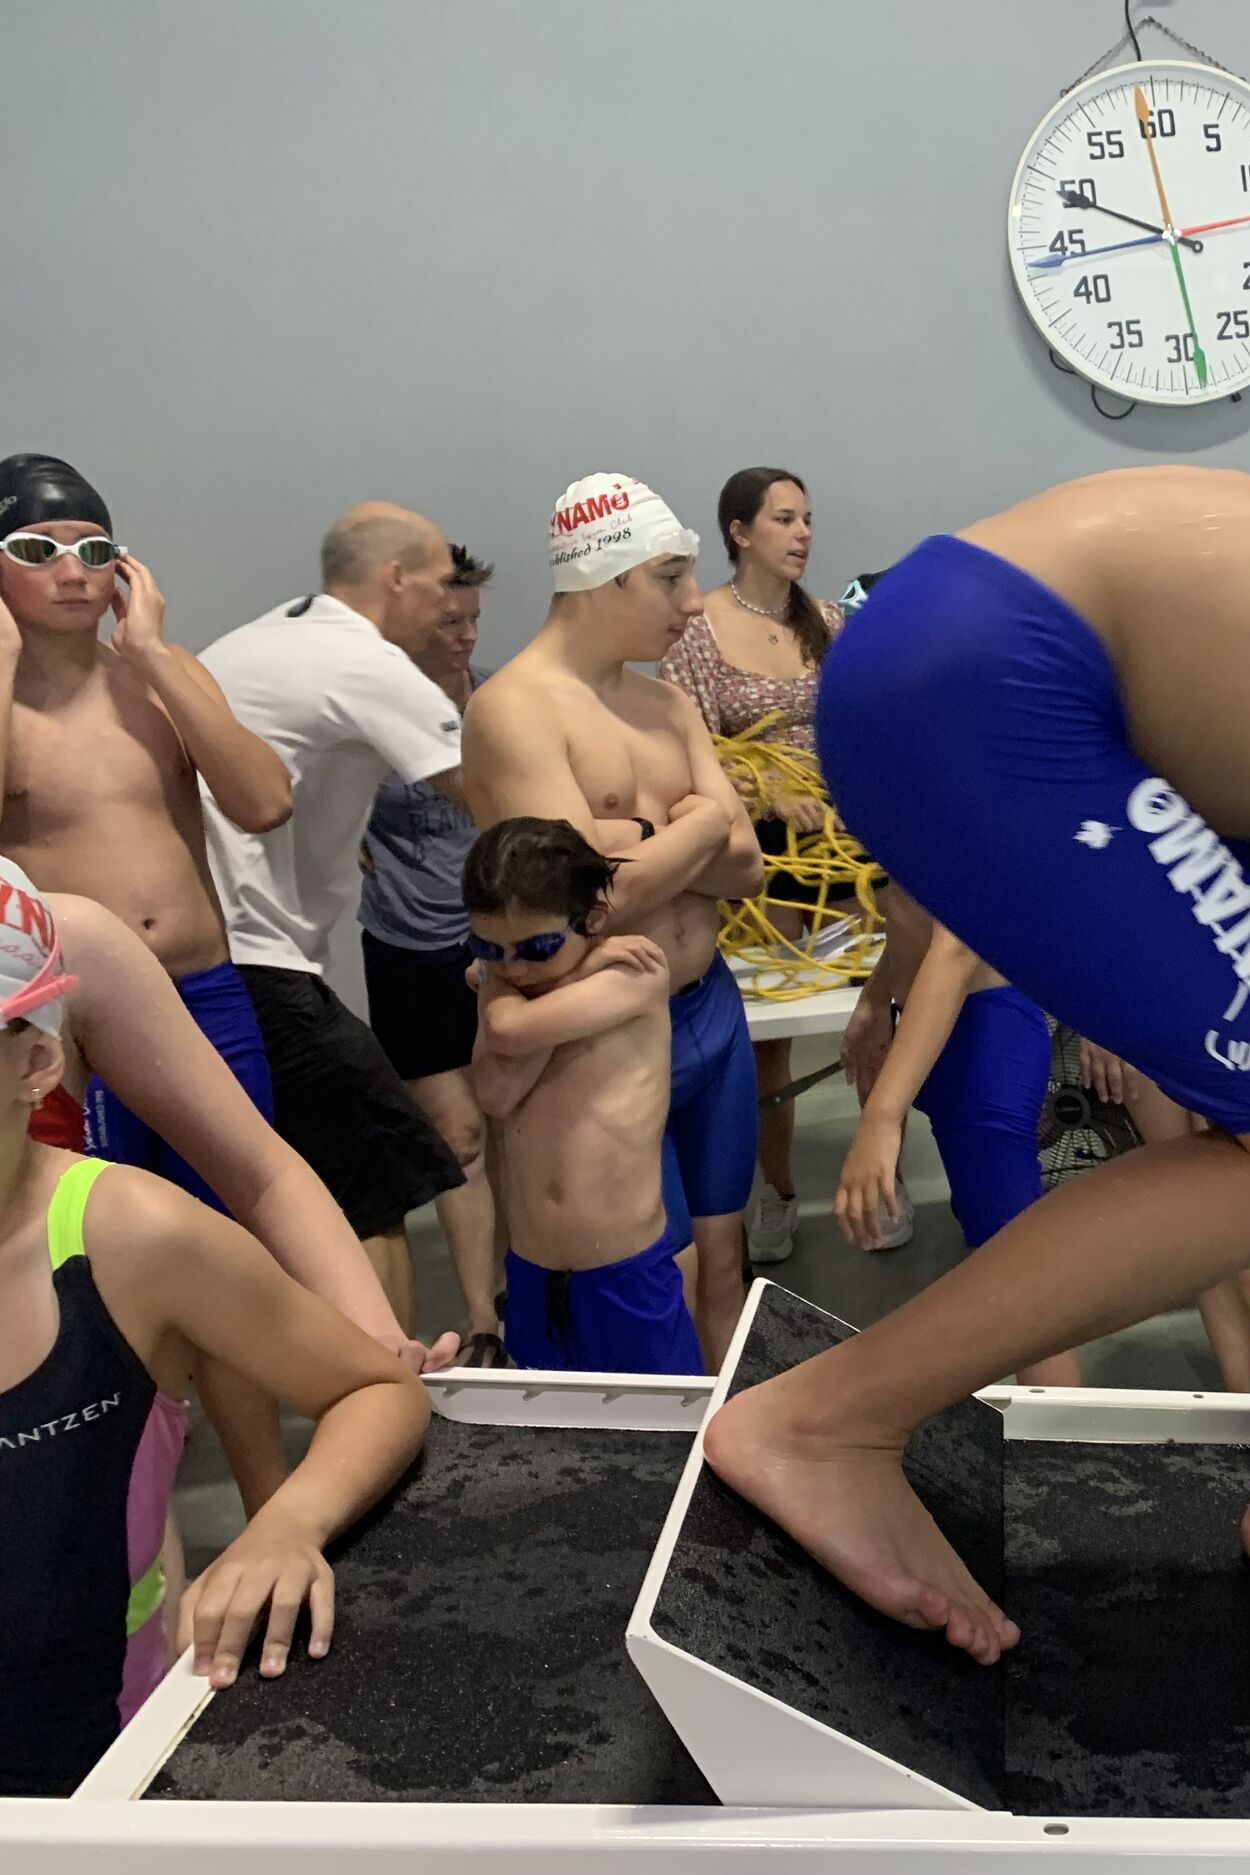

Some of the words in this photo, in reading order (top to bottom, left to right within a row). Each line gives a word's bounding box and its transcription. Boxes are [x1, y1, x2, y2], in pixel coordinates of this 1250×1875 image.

[1139, 108, 1176, 139] 60
[1203, 124, 1222, 152] 5
[1087, 130, 1124, 160] 55
[1049, 229, 1086, 257] 45
[1073, 274, 1111, 304] 40
[1107, 319, 1143, 350] 35
[1216, 310, 1250, 340] 25
[1164, 332, 1197, 363] 30
[551, 491, 629, 534] NAMO
[595, 527, 632, 551] 1998
